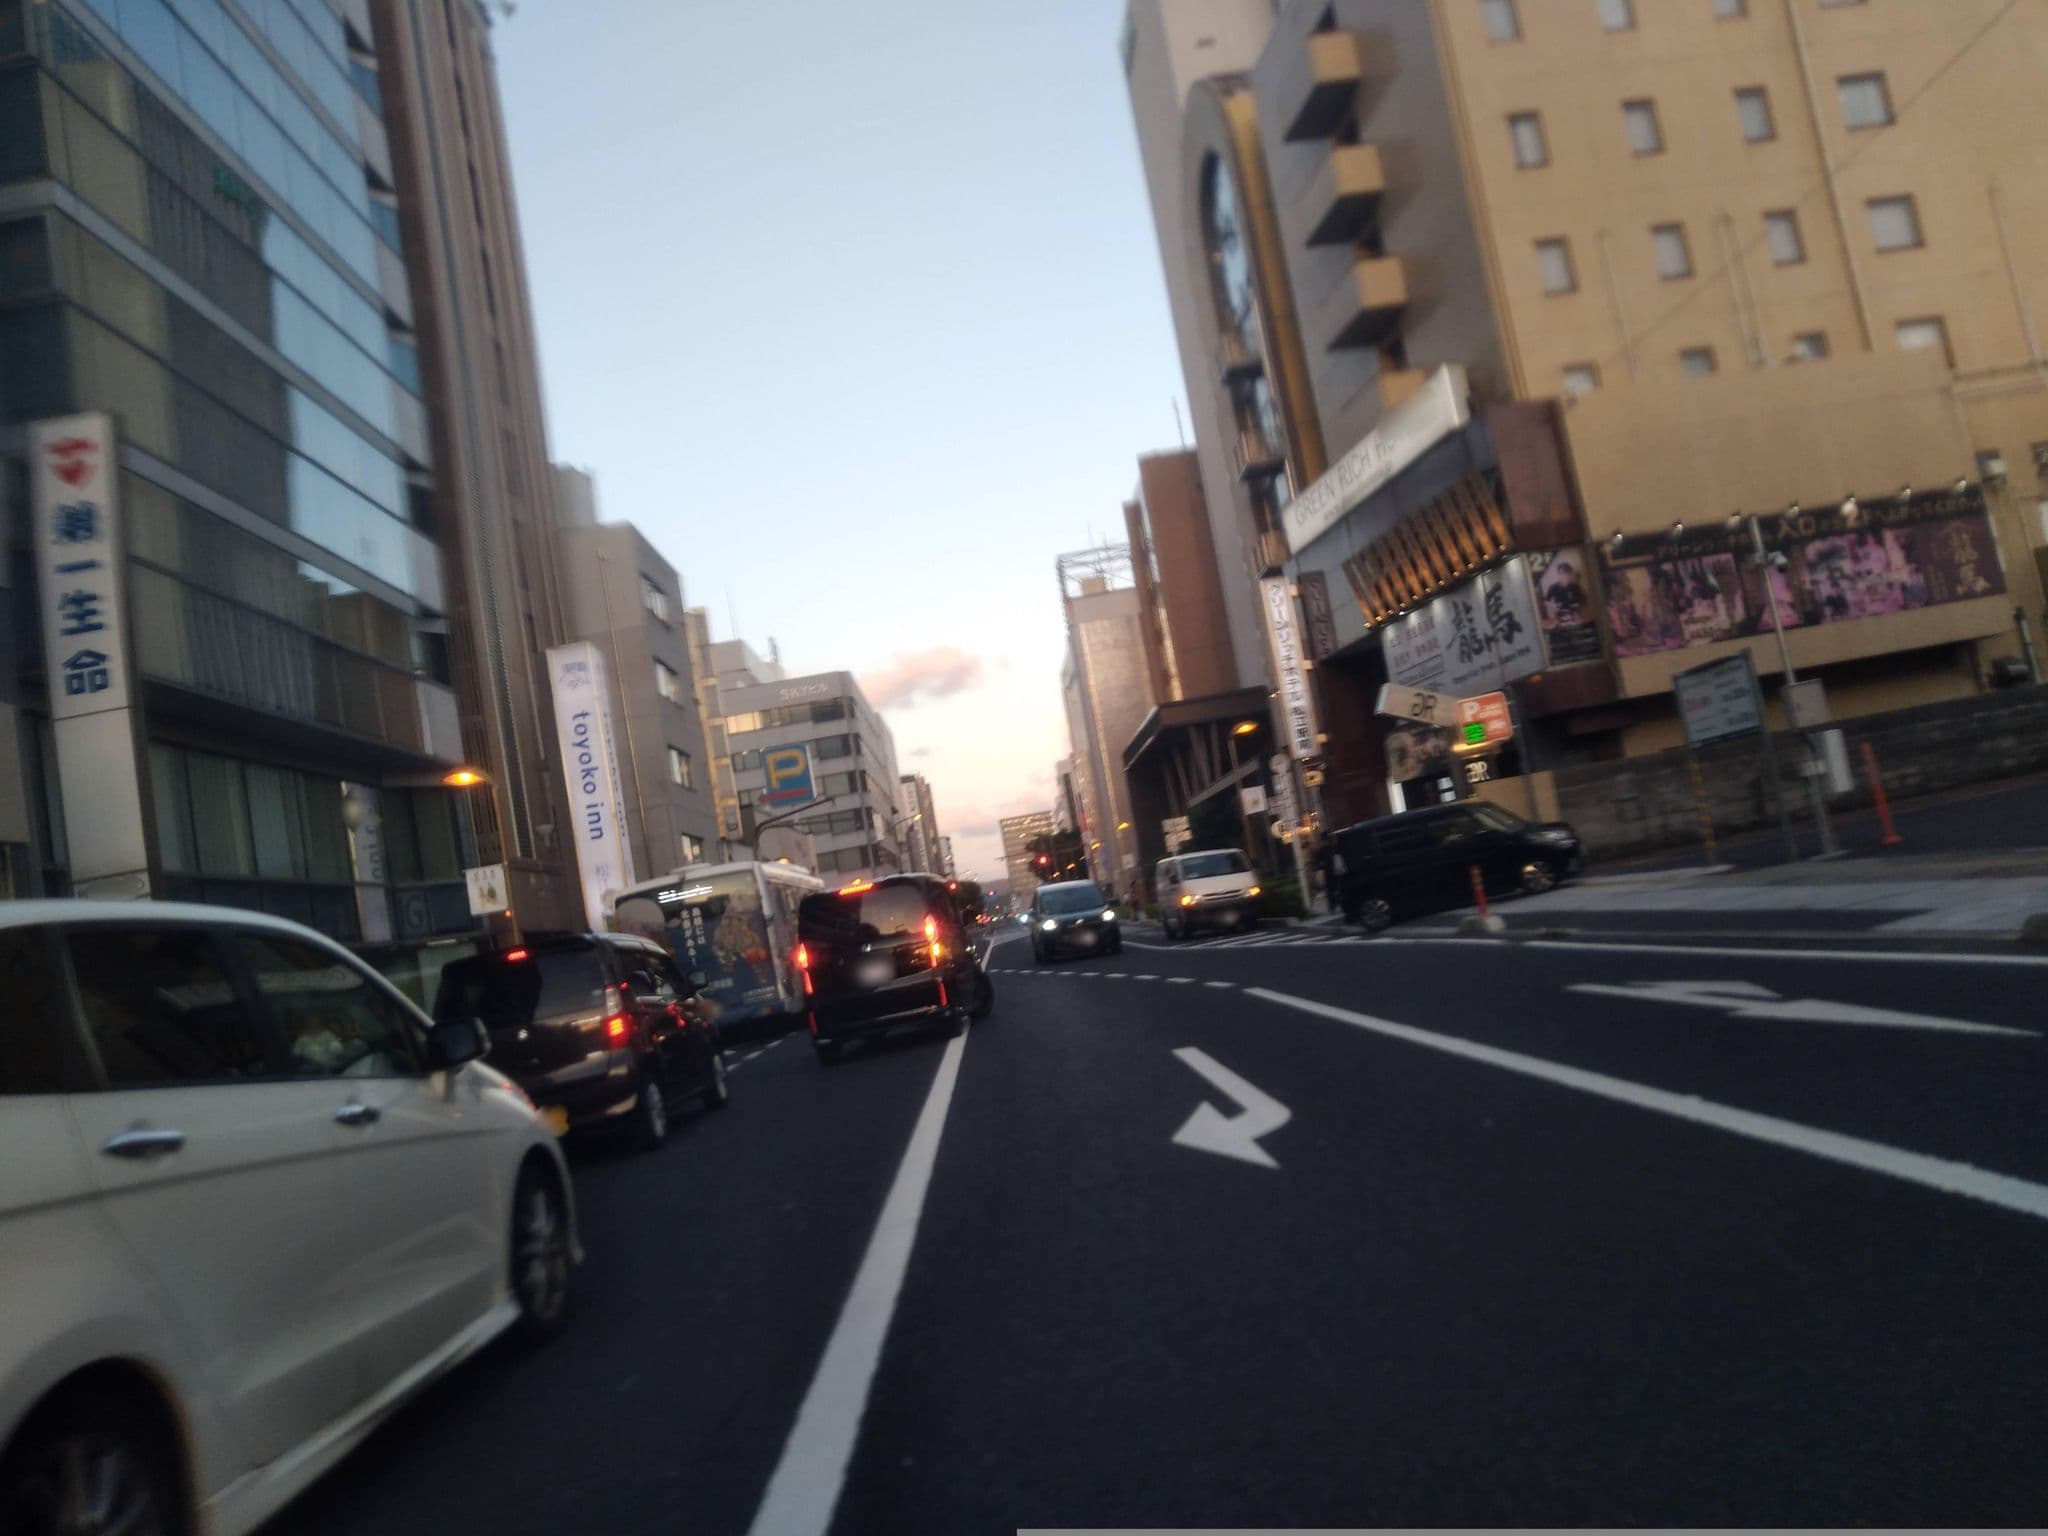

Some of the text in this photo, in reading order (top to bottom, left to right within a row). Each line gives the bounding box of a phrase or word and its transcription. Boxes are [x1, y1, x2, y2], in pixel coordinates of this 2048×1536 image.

[1294, 480, 1335, 526] GREEN
[1338, 451, 1371, 488] RICH
[54, 501, 111, 697] 第一生命
[1462, 701, 1480, 722] P
[572, 711, 599, 794] toyoko
[586, 802, 604, 841] inn
[766, 748, 806, 790] P
